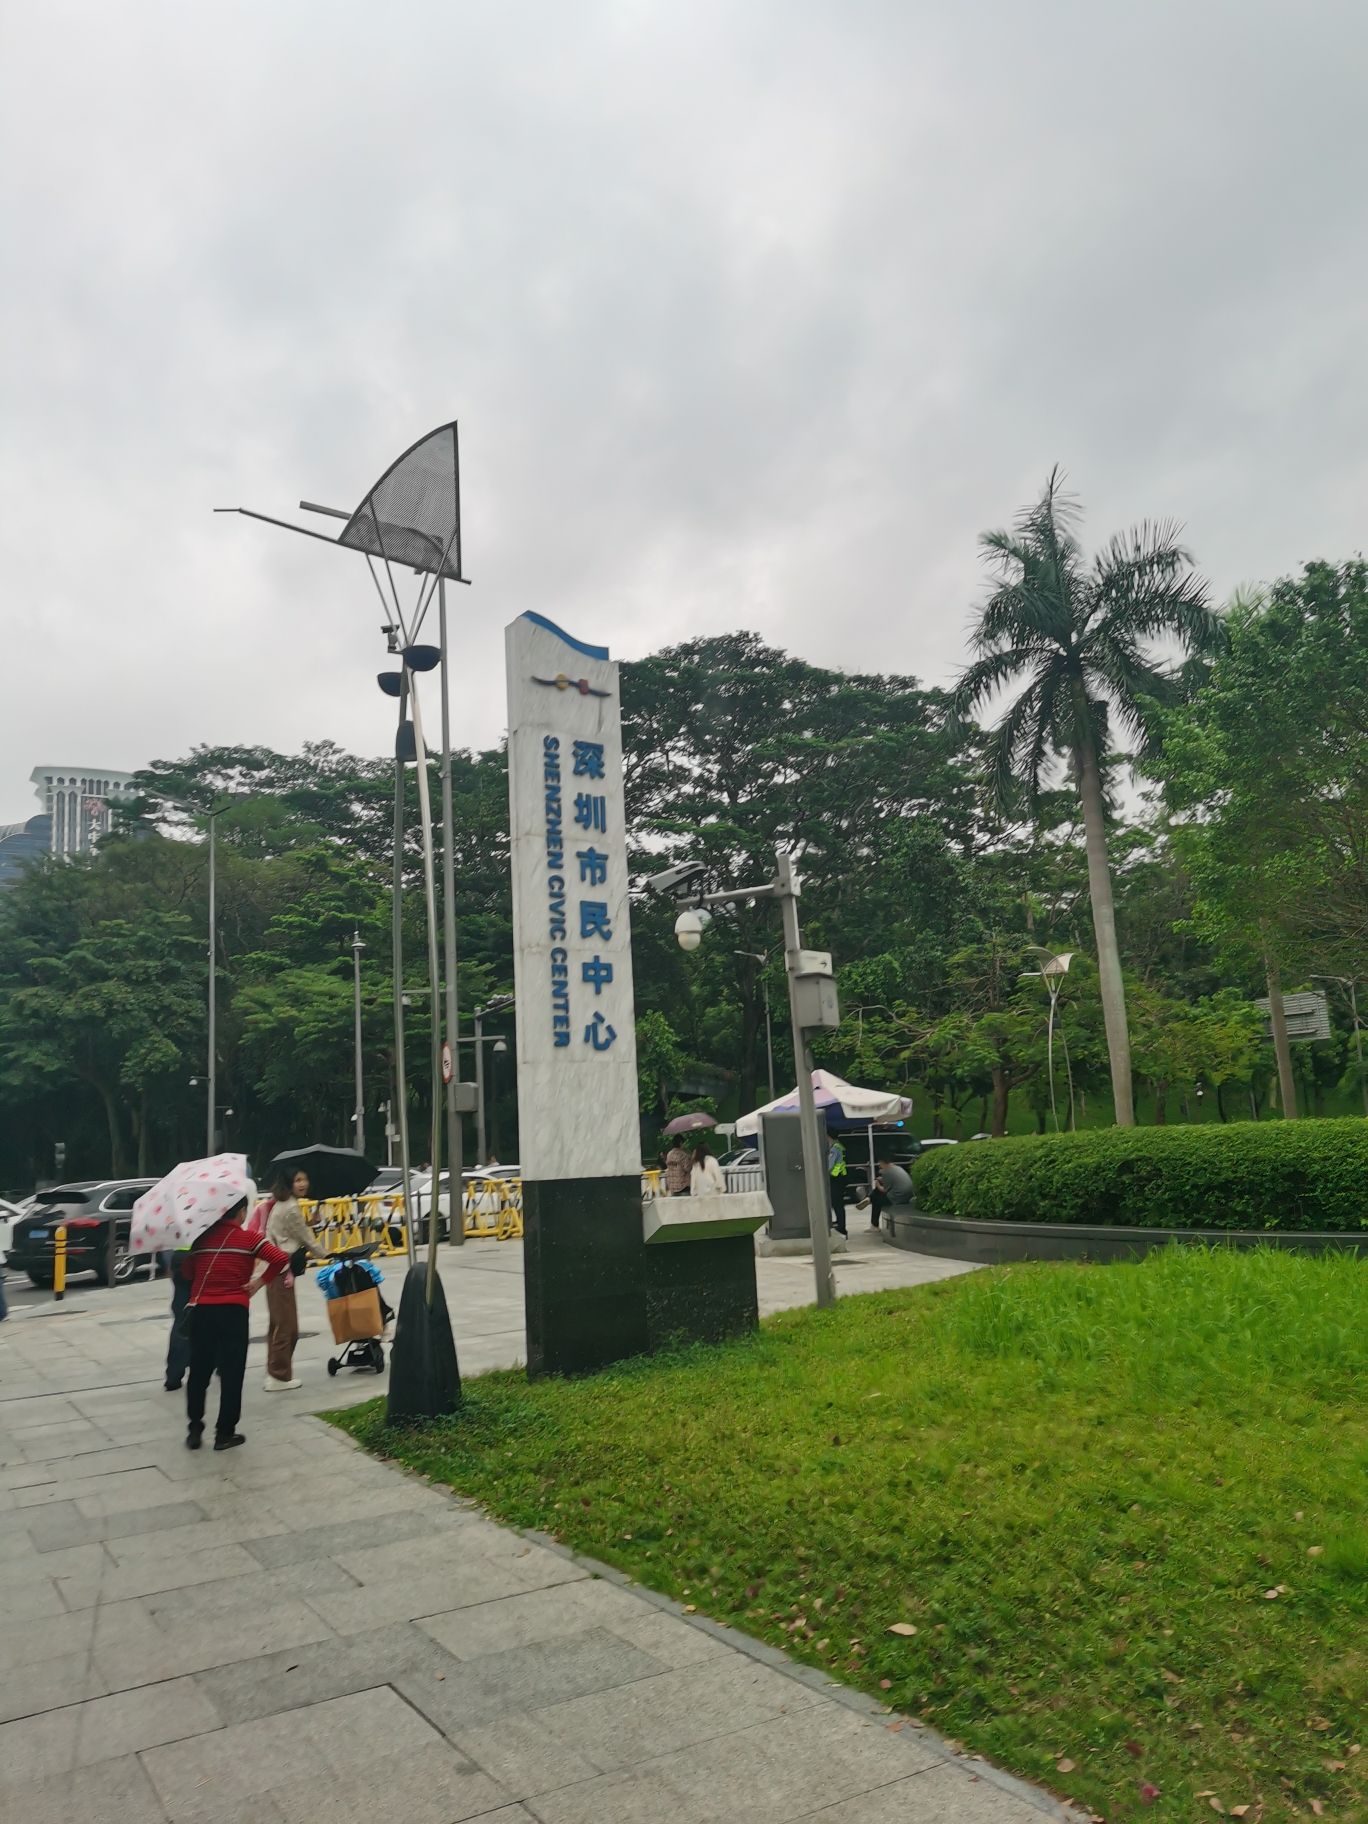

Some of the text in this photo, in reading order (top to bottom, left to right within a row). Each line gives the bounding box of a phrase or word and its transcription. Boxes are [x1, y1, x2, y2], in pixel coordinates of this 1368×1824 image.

[543, 734, 570, 1048] SHENZHEN CIVIC CENTER
[572, 739, 617, 1051] 深圳市民中心
